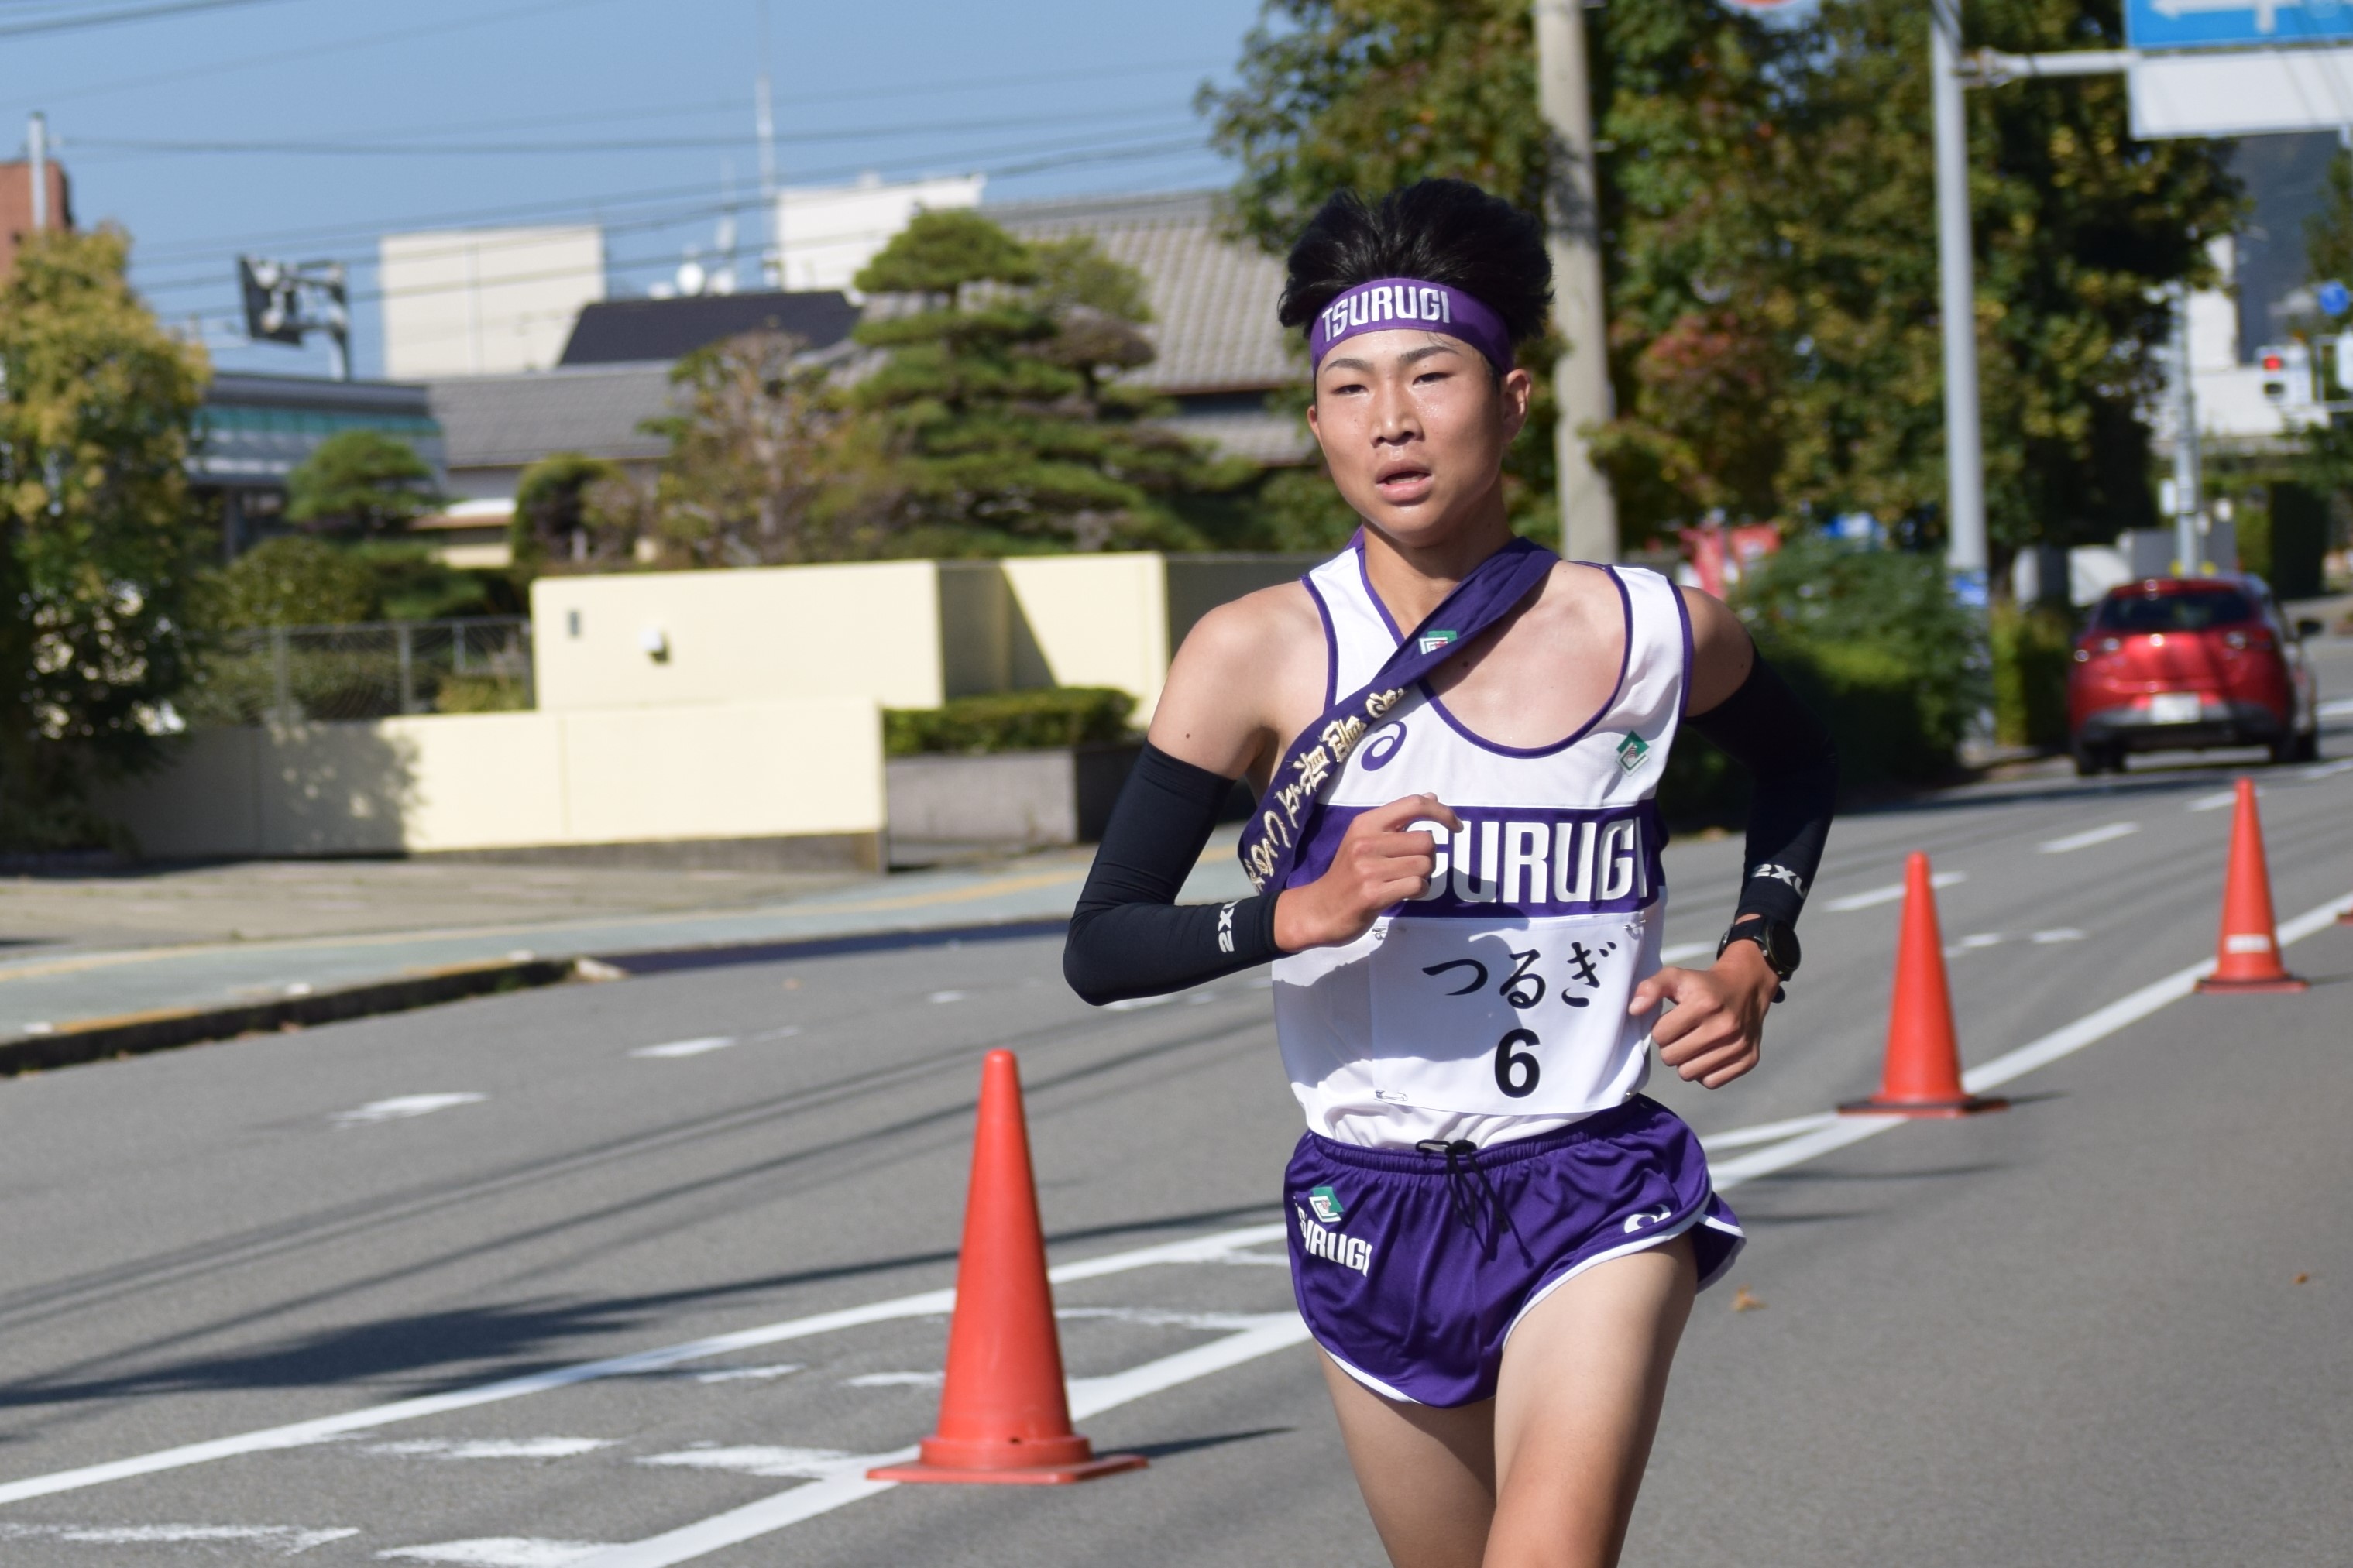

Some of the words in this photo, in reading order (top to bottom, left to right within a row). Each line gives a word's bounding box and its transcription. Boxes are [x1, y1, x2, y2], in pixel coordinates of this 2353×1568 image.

[1322, 286, 1450, 342] TSURUGI
[1403, 816, 1647, 904] SURUGI
[1422, 941, 1617, 1010] つるぎ
[1494, 1028, 1541, 1099] 6
